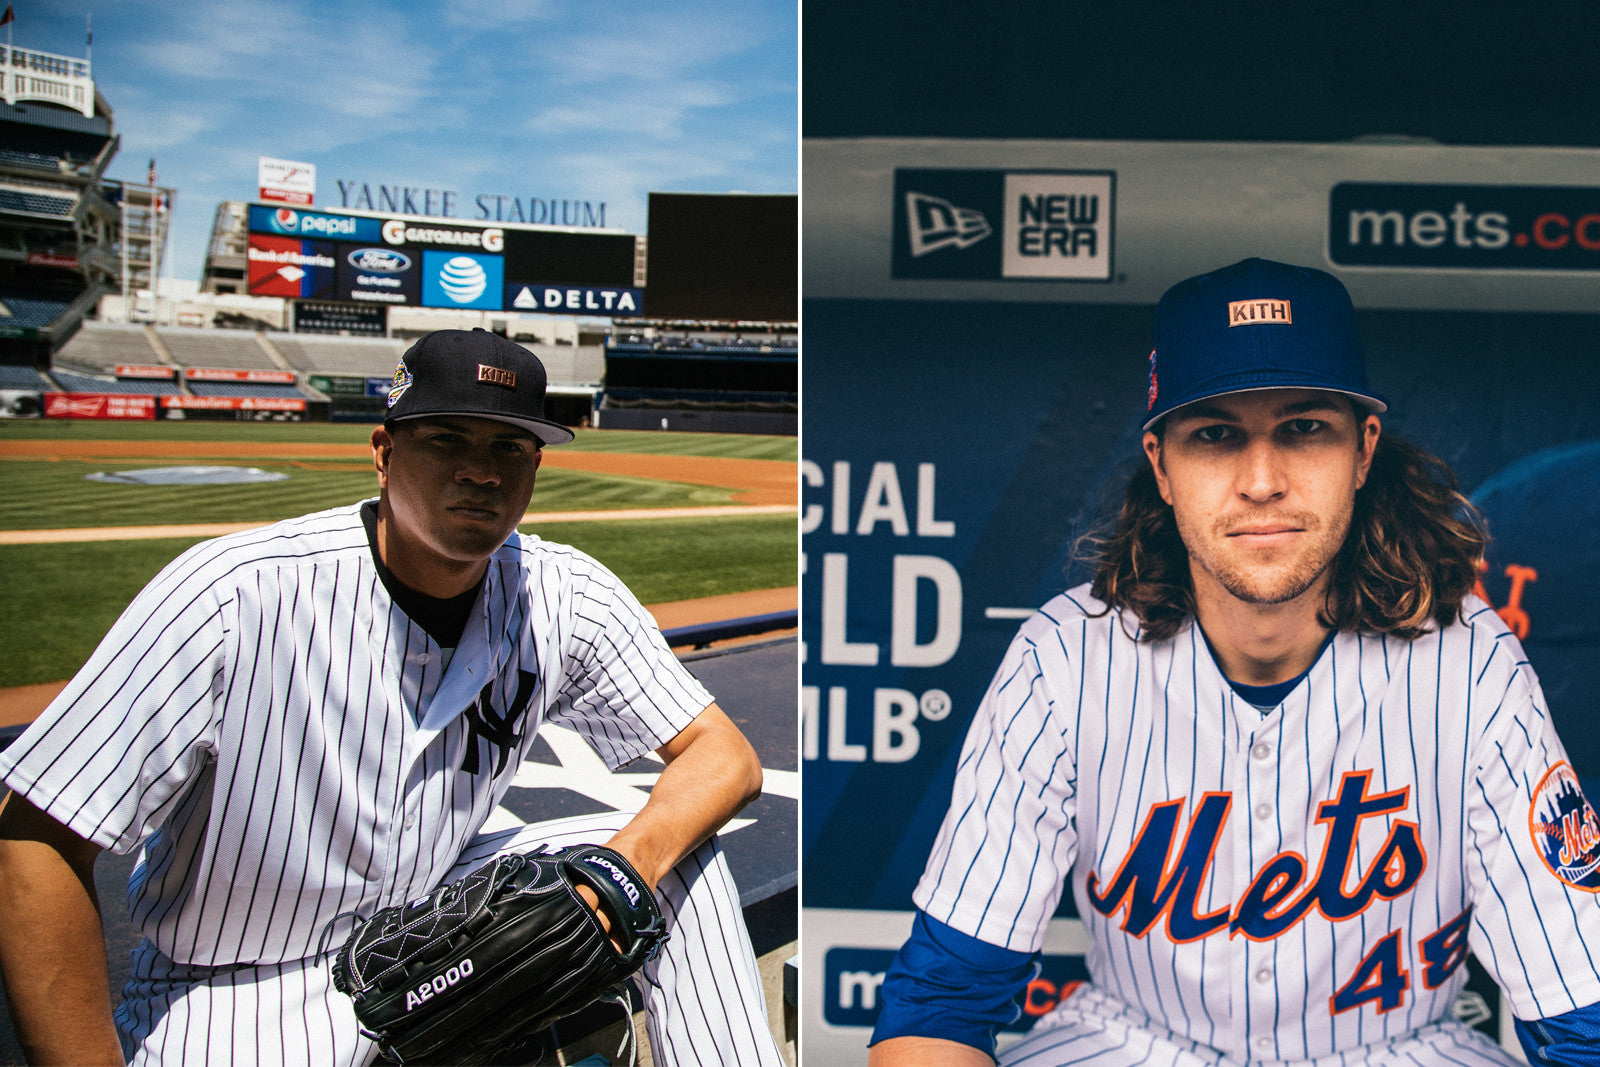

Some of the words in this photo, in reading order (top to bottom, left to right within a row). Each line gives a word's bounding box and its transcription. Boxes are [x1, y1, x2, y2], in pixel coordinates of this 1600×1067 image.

[337, 179, 457, 218] YANKEE
[474, 193, 606, 228] STADIUM
[1018, 194, 1098, 225] NEW
[301, 215, 356, 236] pepsi
[405, 227, 481, 246] GATORADE
[1018, 226, 1098, 257] ERA
[544, 288, 635, 311] DELTA
[1232, 302, 1287, 322] KITH
[480, 366, 517, 387] KITH
[800, 553, 963, 668] LD
[1559, 804, 1600, 867] Met
[1087, 769, 1427, 944] Mets
[1329, 902, 1473, 1017] 48
[406, 957, 475, 1012] A2000
